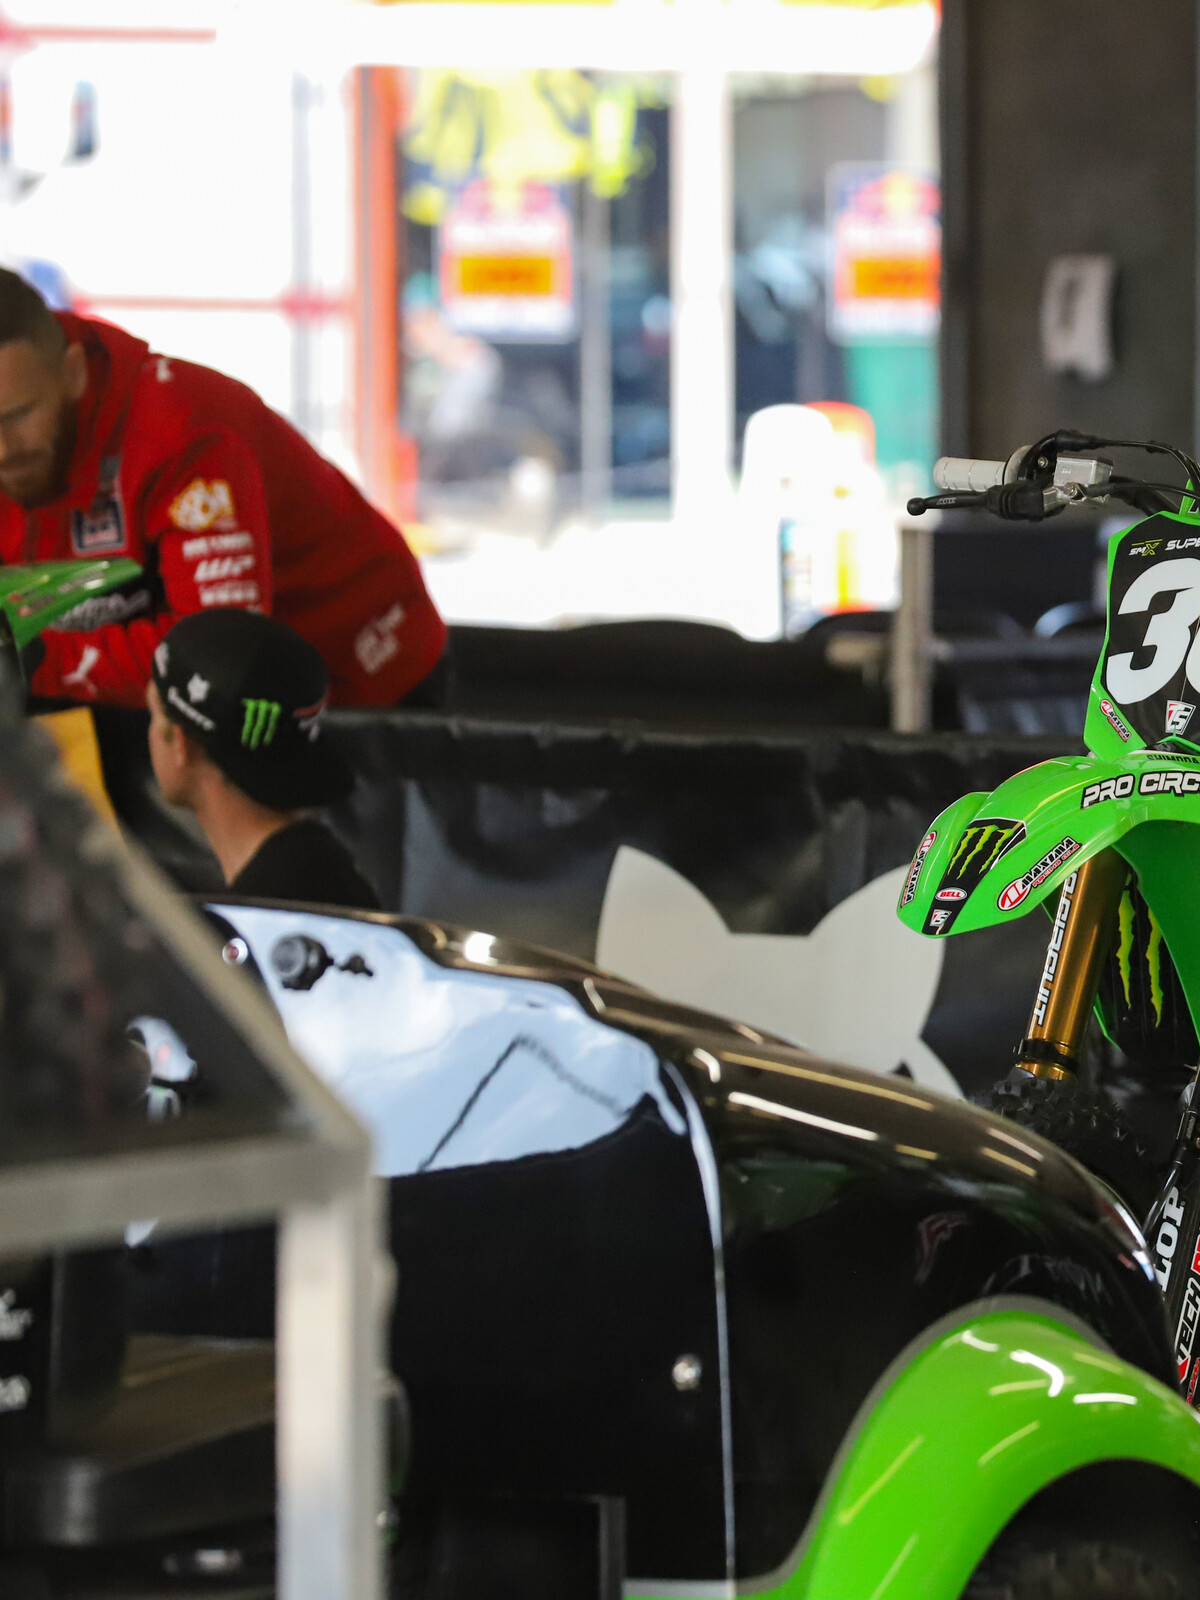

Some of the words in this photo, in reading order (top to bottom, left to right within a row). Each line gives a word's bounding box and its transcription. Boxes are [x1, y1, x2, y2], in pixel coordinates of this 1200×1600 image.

[1082, 774, 1135, 809] PRO
[1021, 837, 1076, 890] MAXIMA
[940, 890, 961, 899] BELL
